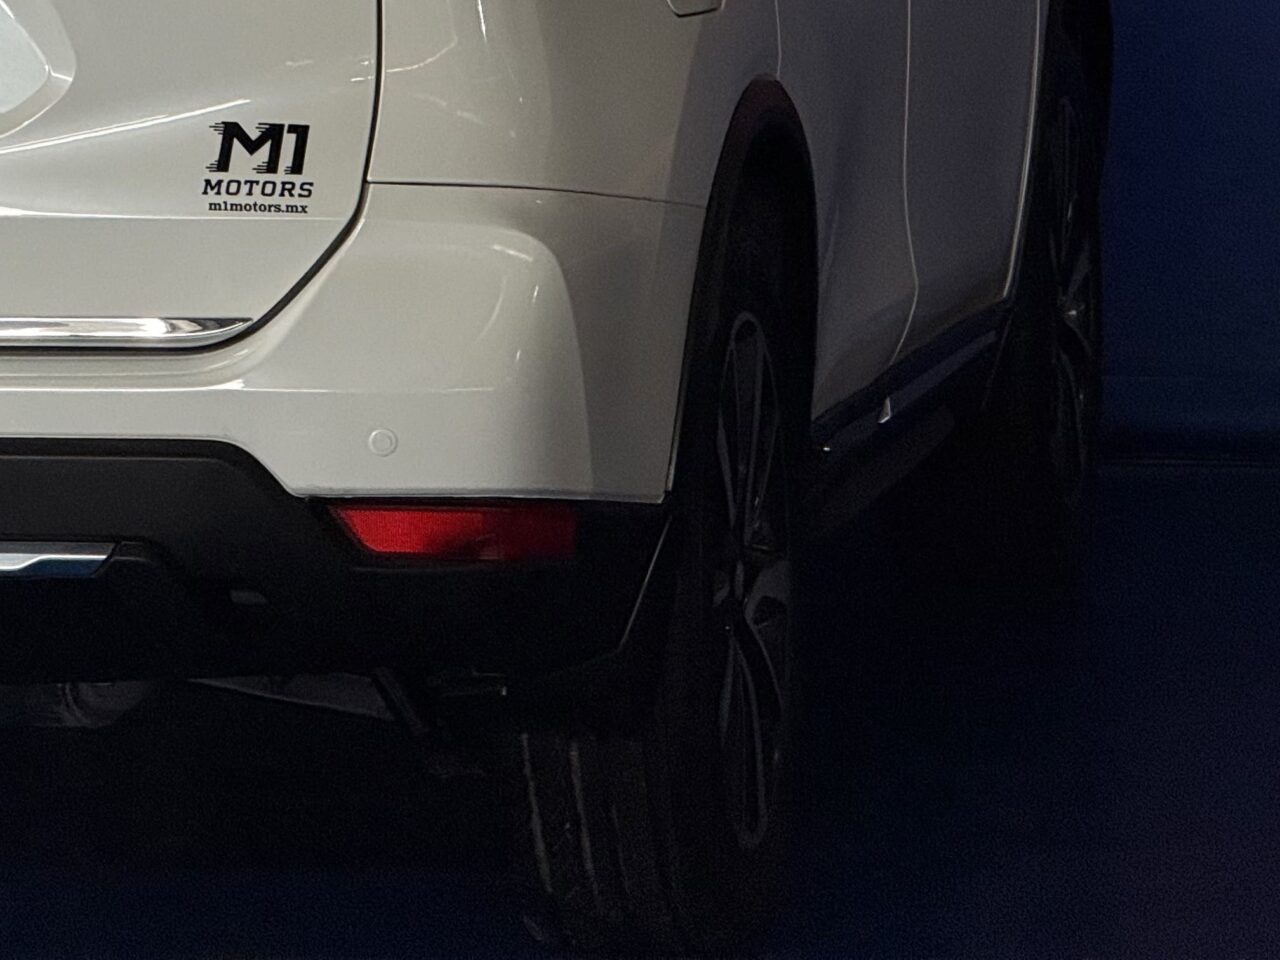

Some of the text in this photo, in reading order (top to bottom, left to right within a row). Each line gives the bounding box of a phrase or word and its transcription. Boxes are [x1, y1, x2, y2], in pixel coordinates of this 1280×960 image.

[205, 120, 311, 176] M1
[201, 178, 315, 199] MOTORS
[208, 200, 309, 214] m1motors.mx
